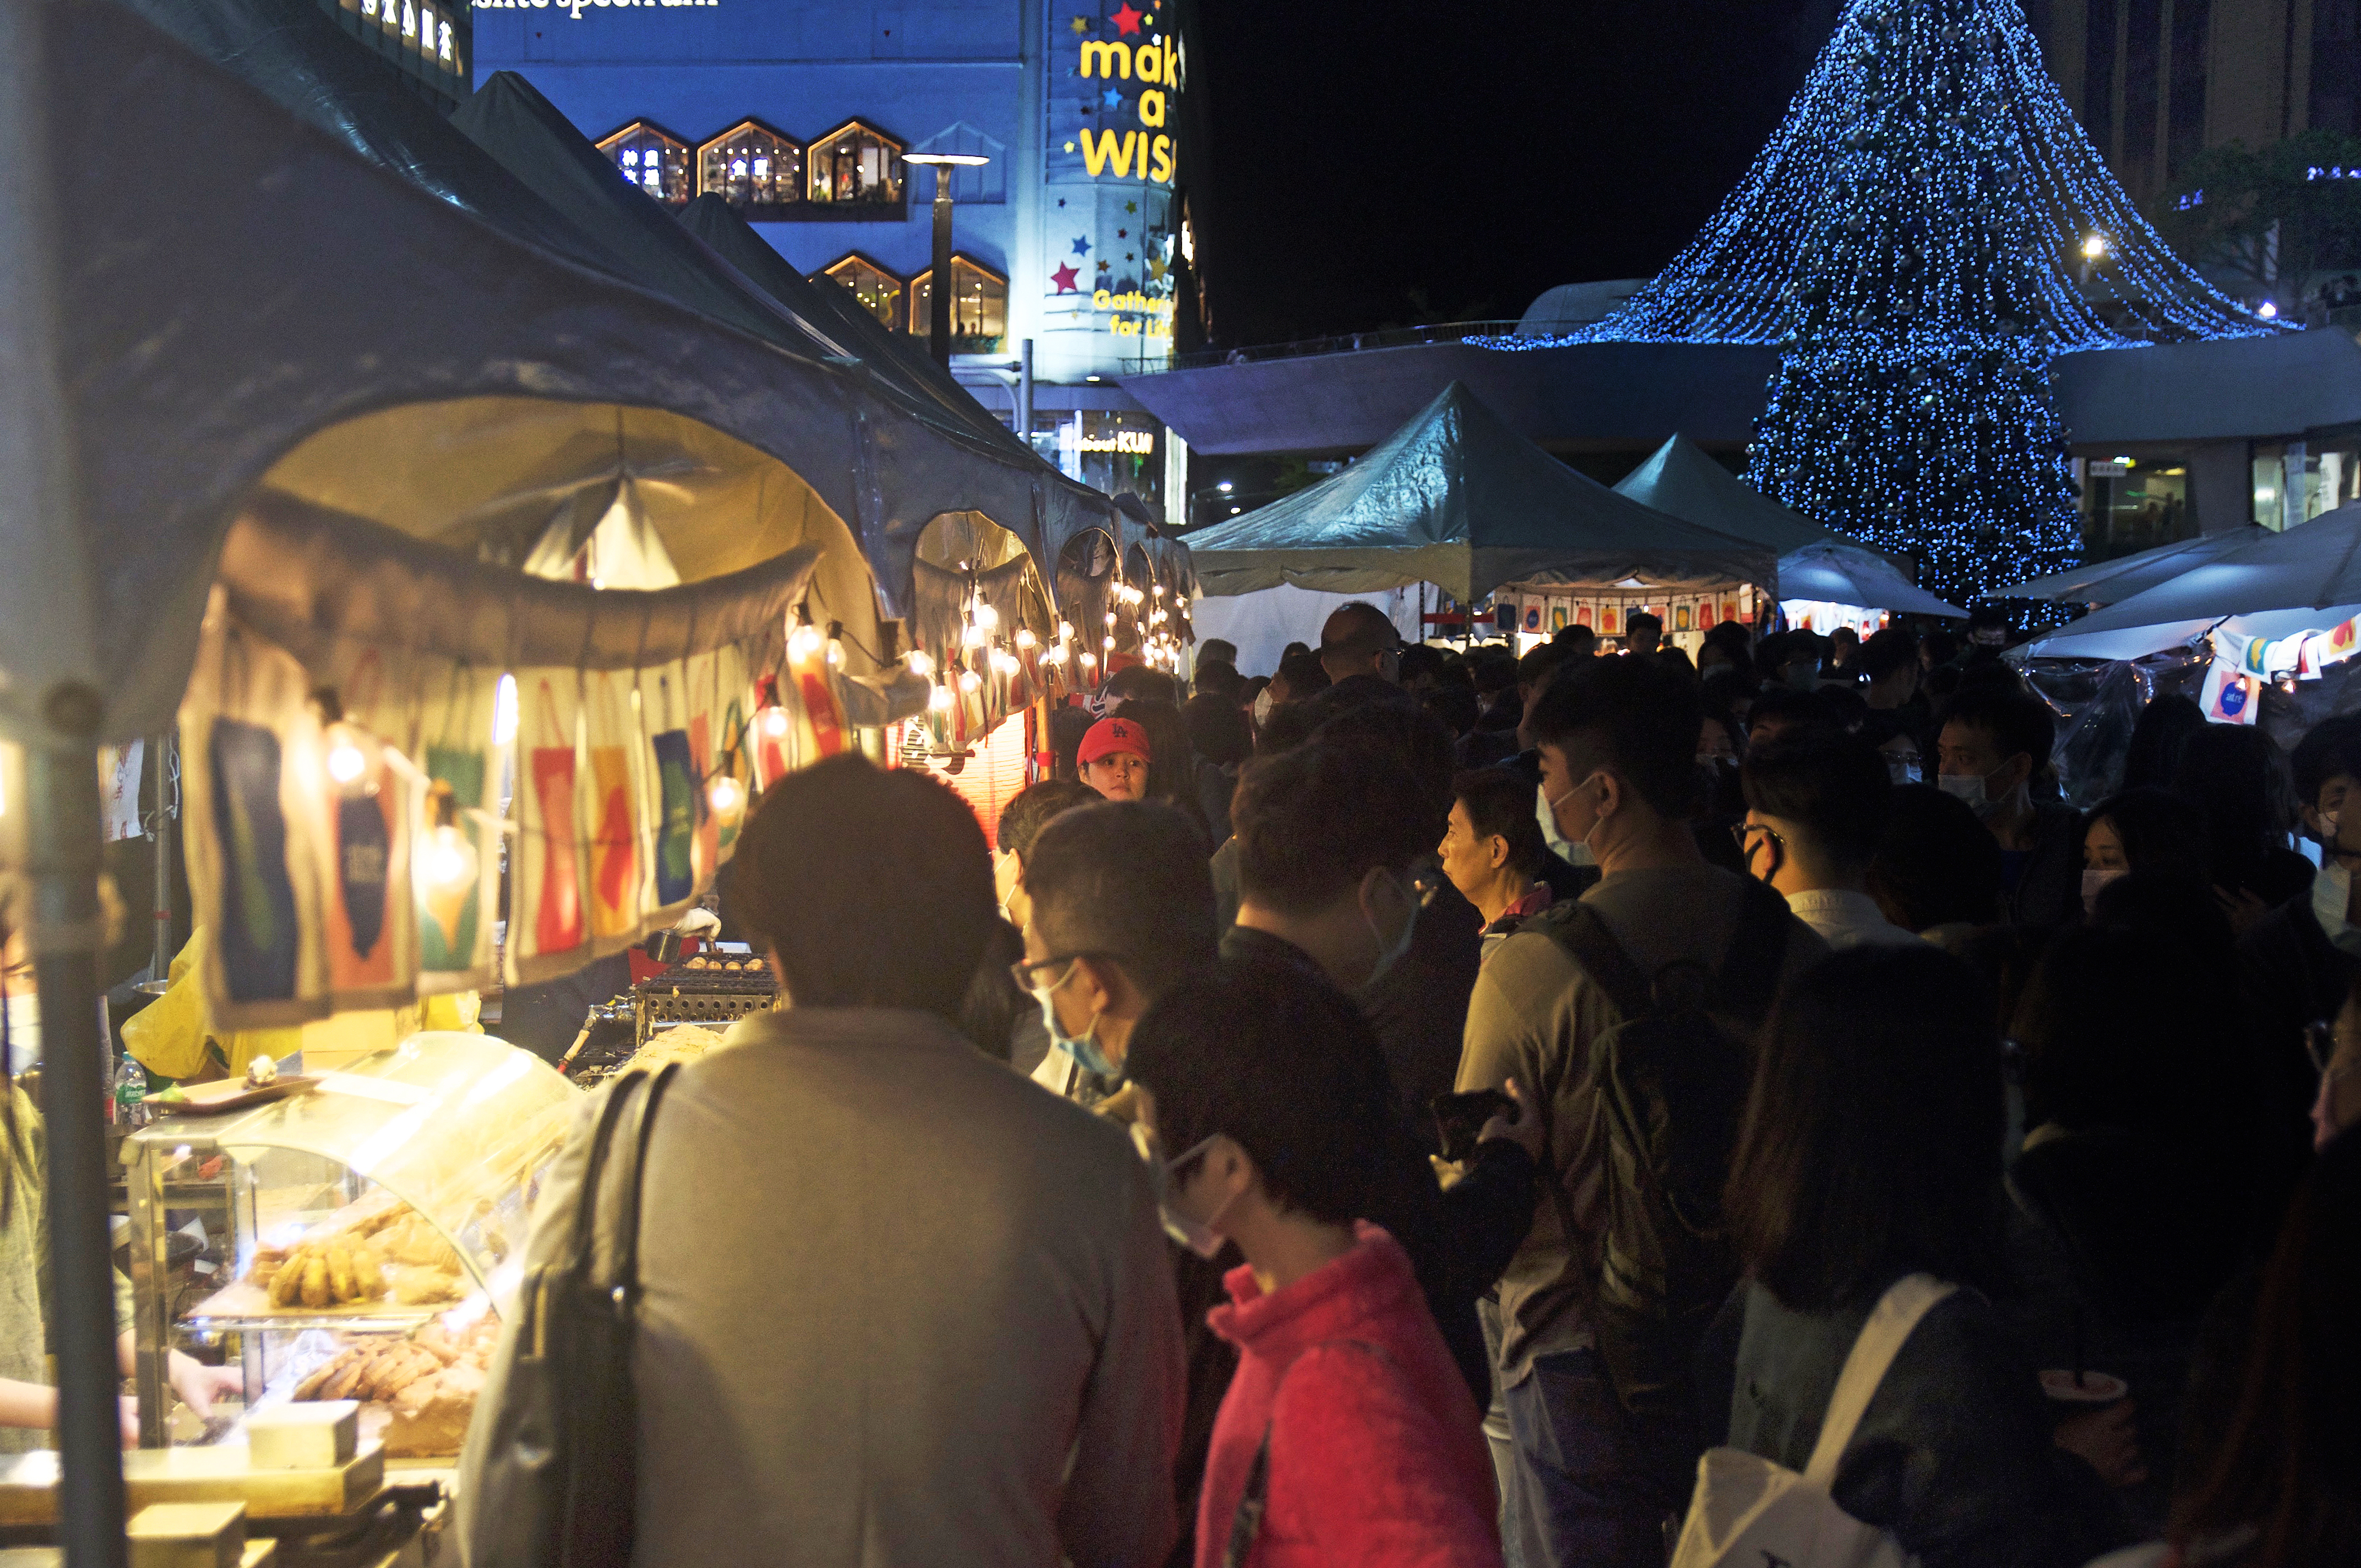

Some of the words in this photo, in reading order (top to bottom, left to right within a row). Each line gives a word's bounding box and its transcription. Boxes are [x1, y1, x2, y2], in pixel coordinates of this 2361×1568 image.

[1139, 89, 1165, 128] a
[1110, 314, 1142, 336] for
[1113, 723, 1127, 737] LA
